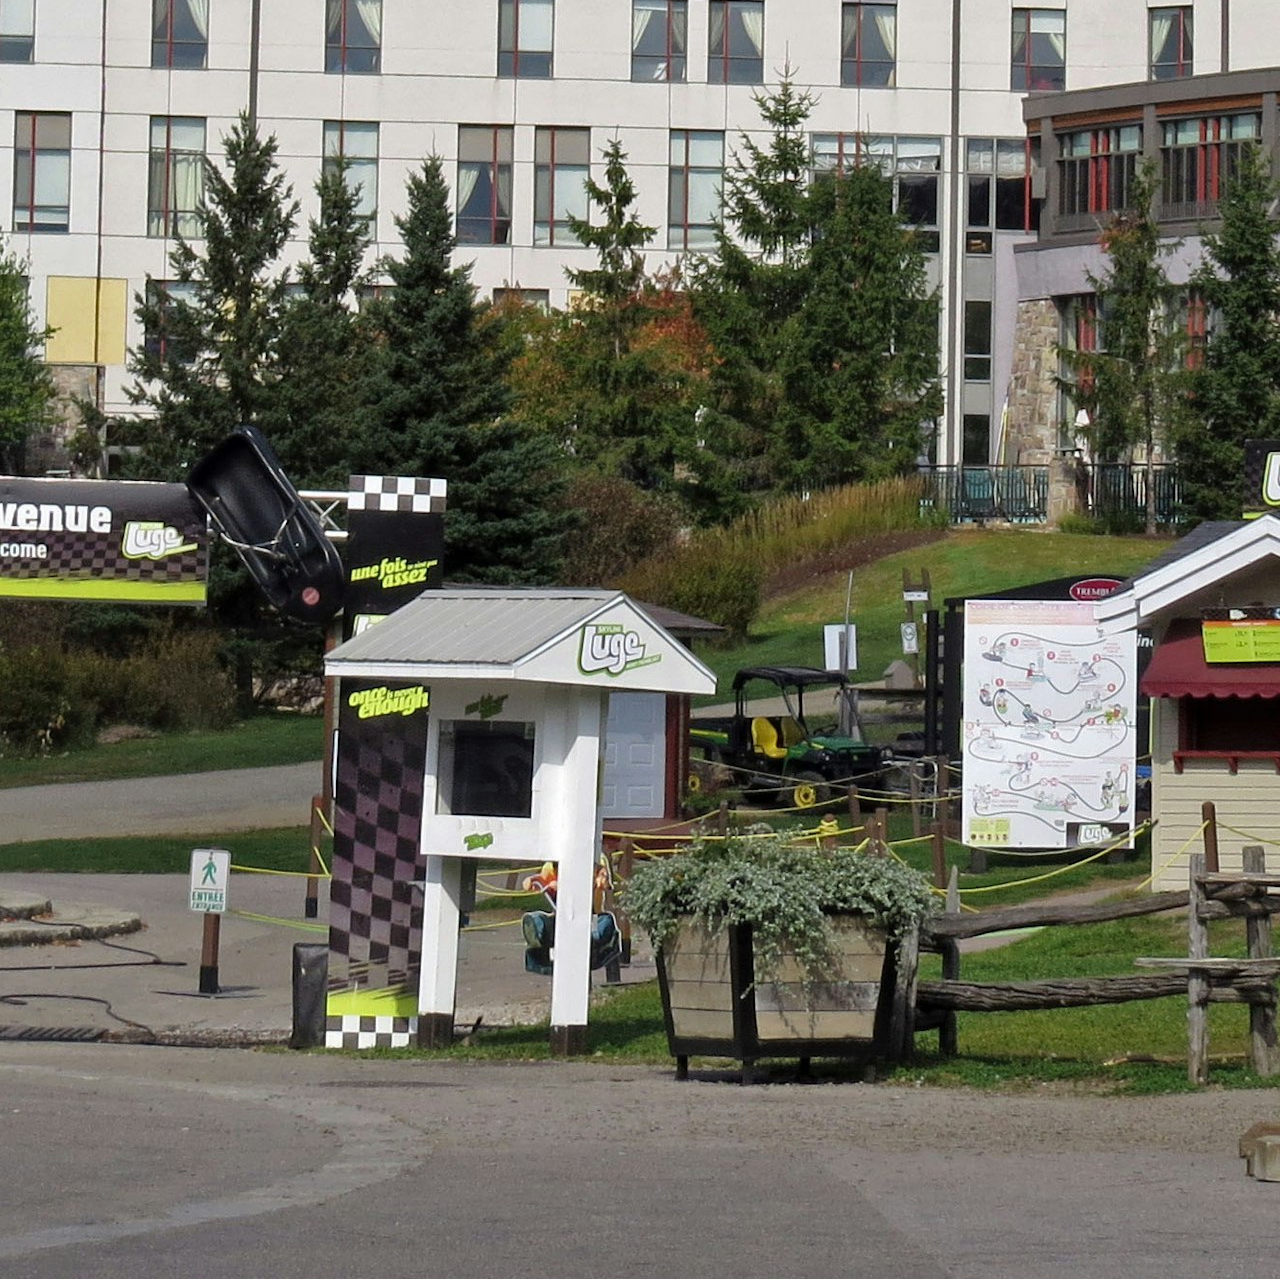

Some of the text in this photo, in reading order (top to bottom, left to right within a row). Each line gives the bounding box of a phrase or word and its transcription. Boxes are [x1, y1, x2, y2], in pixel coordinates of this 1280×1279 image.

[124, 522, 185, 559] Luge
[351, 566, 379, 582] une
[378, 557, 408, 580] fois
[381, 568, 428, 589] assez
[580, 625, 644, 674] Luge
[348, 686, 387, 707] once
[358, 686, 429, 720] enough
